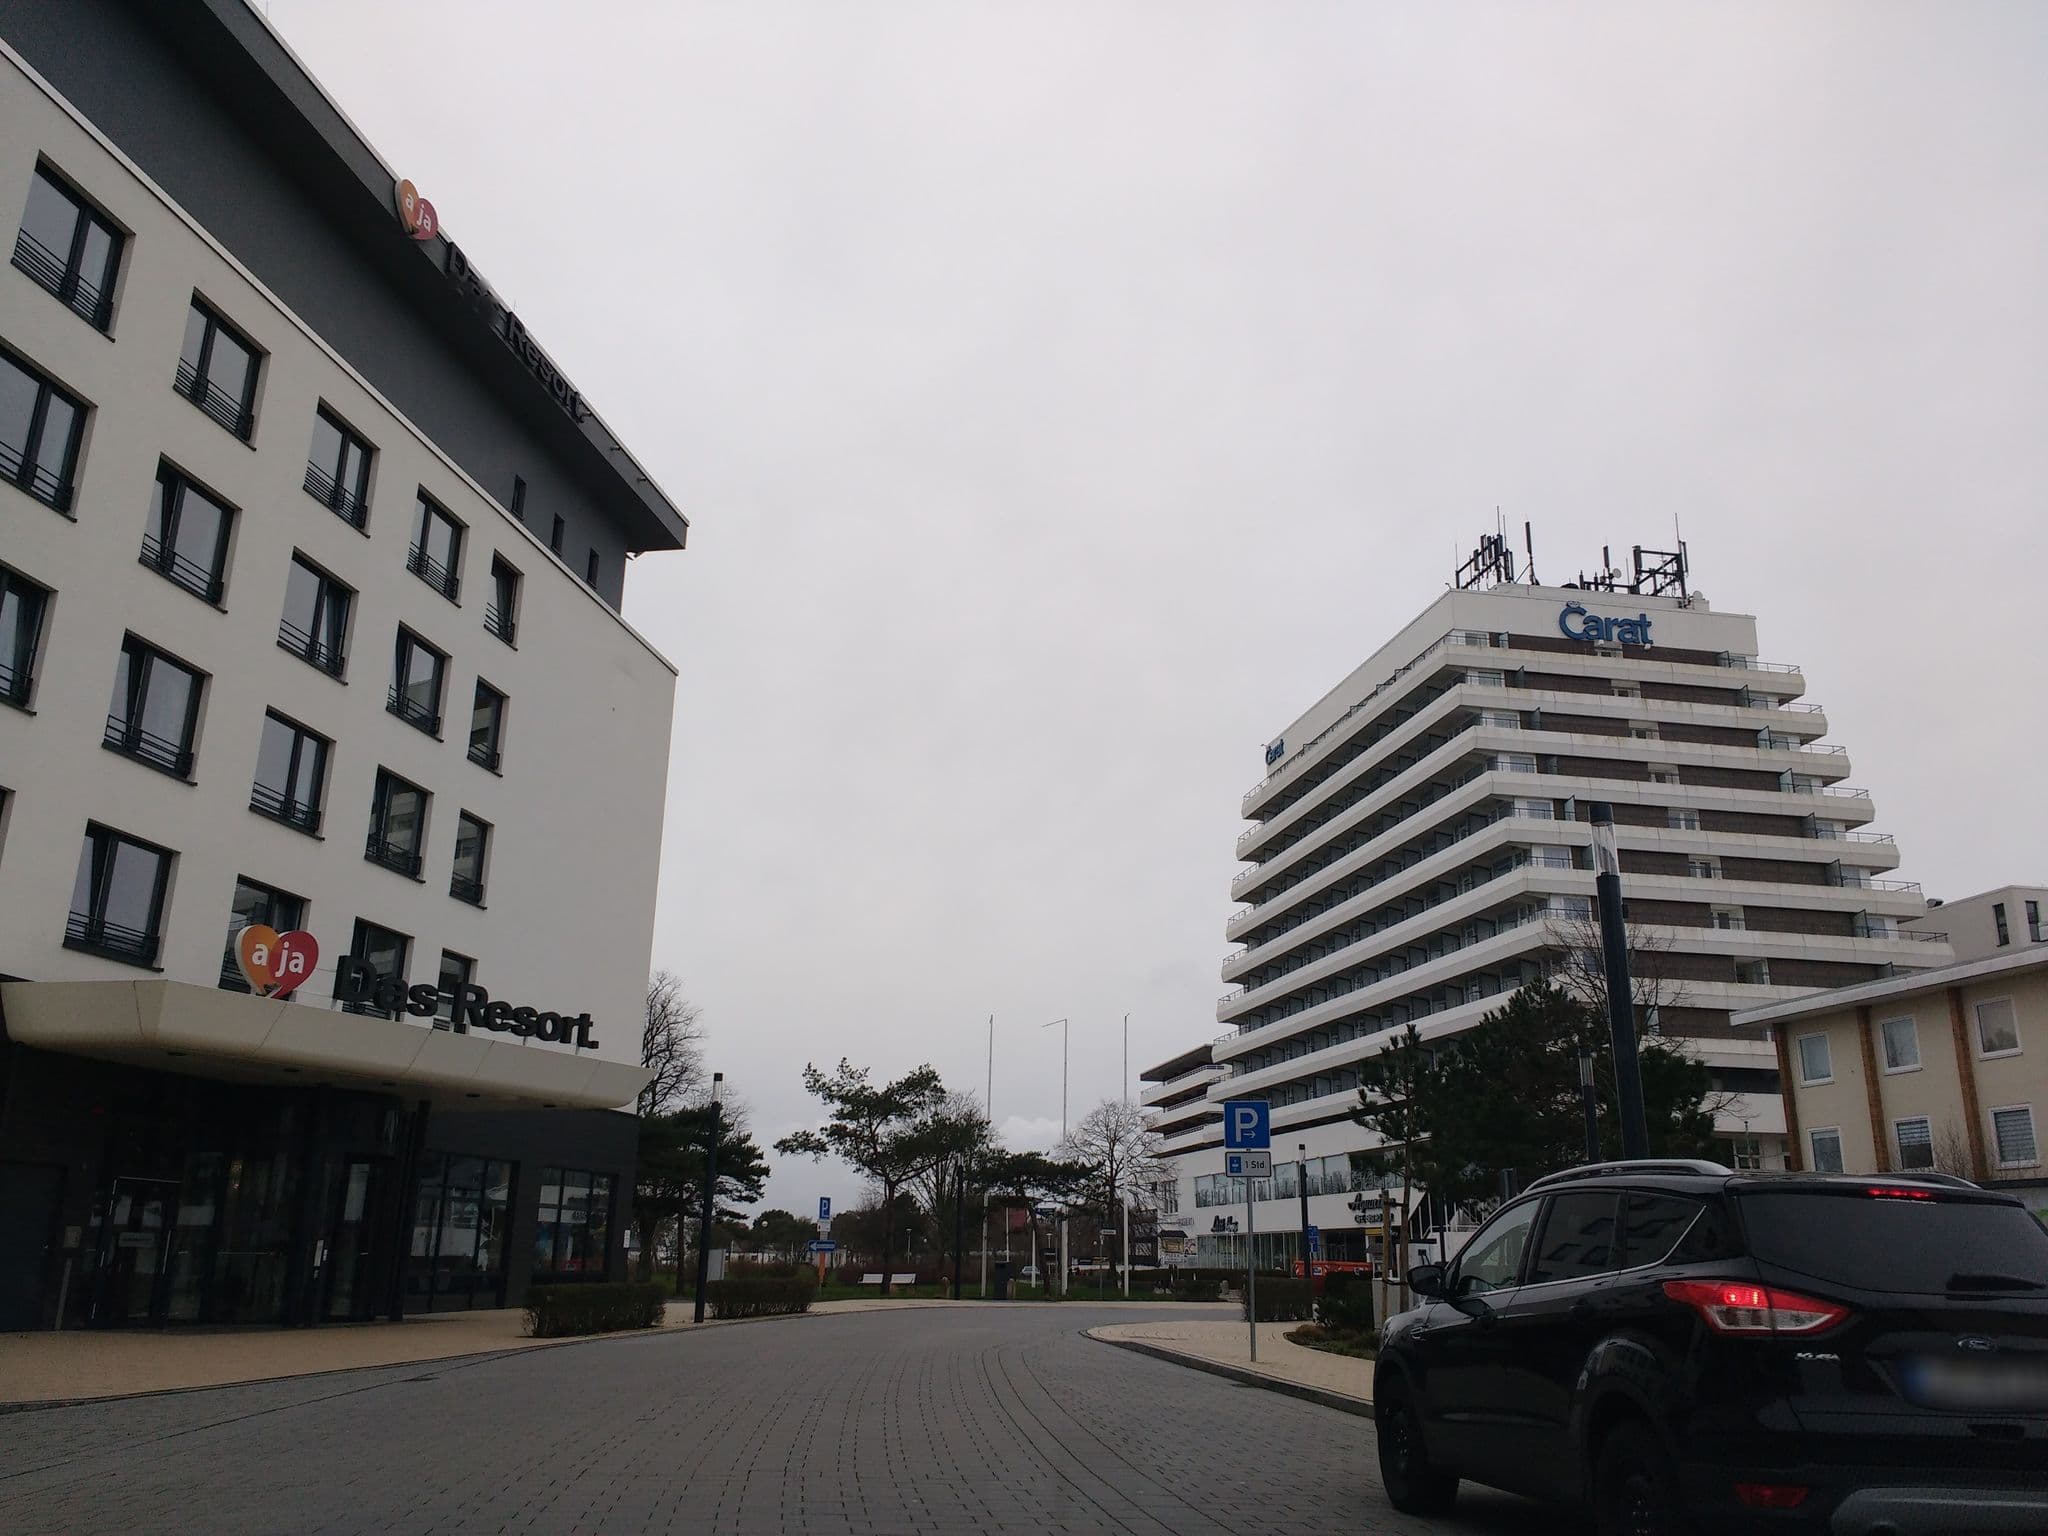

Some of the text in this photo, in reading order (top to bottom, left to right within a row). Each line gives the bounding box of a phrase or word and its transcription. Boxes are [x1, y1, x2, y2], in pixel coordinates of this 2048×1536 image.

[1559, 602, 1653, 645] Carat
[333, 955, 438, 1016] Das
[1235, 1107, 1259, 1143] P
[822, 1200, 829, 1217] P
